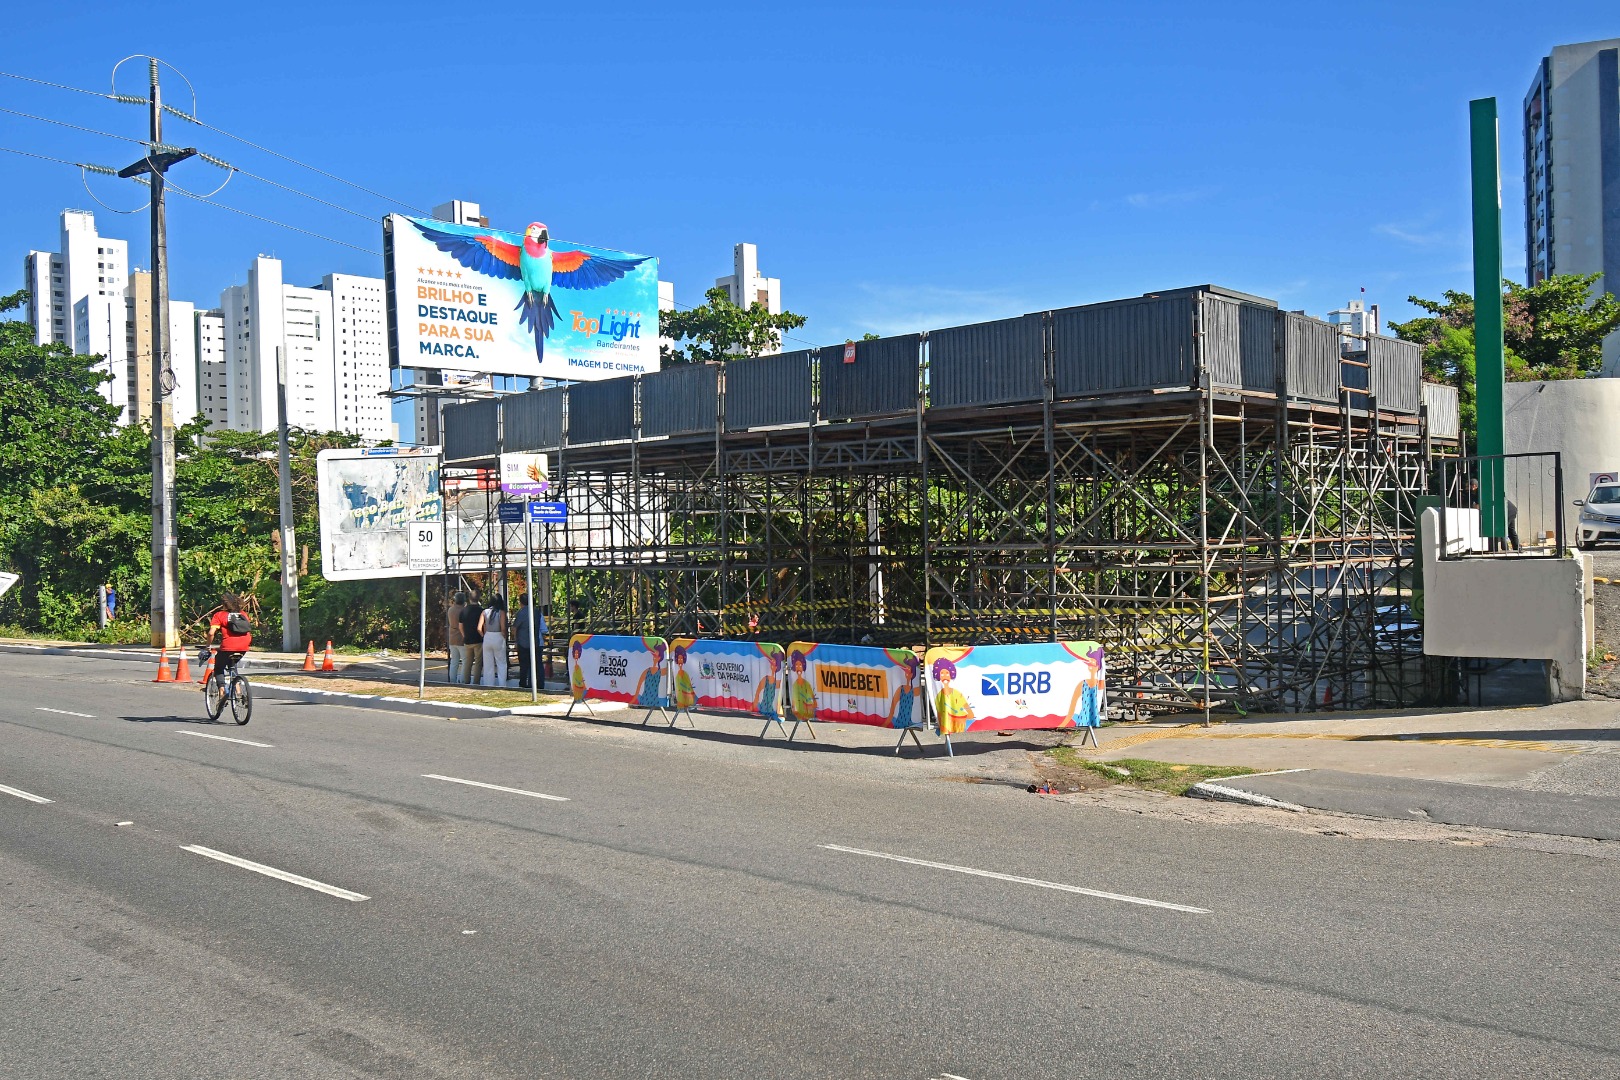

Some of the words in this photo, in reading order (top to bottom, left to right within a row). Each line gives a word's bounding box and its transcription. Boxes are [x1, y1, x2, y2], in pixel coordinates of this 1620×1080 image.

[417, 285, 474, 305] BRILHO
[478, 293, 487, 306] E
[418, 304, 498, 325] DESTAQUE
[418, 322, 461, 340] PARA
[464, 327, 495, 342] SUA
[569, 310, 641, 342] TopLight
[419, 341, 480, 359] MARCA.
[596, 340, 640, 351] Bandeirantes
[568, 358, 601, 369] IMAGEM
[602, 361, 614, 370] DE
[615, 362, 646, 373] CINEMA
[506, 463, 519, 472] SIM
[418, 530, 433, 542] 50
[608, 655, 628, 668] JOÃO
[716, 662, 745, 673] GOVERNO
[598, 666, 627, 677] PESSOA
[717, 671, 726, 681] DA
[821, 670, 881, 693] VAIDEBET
[1007, 671, 1052, 695] BRB
